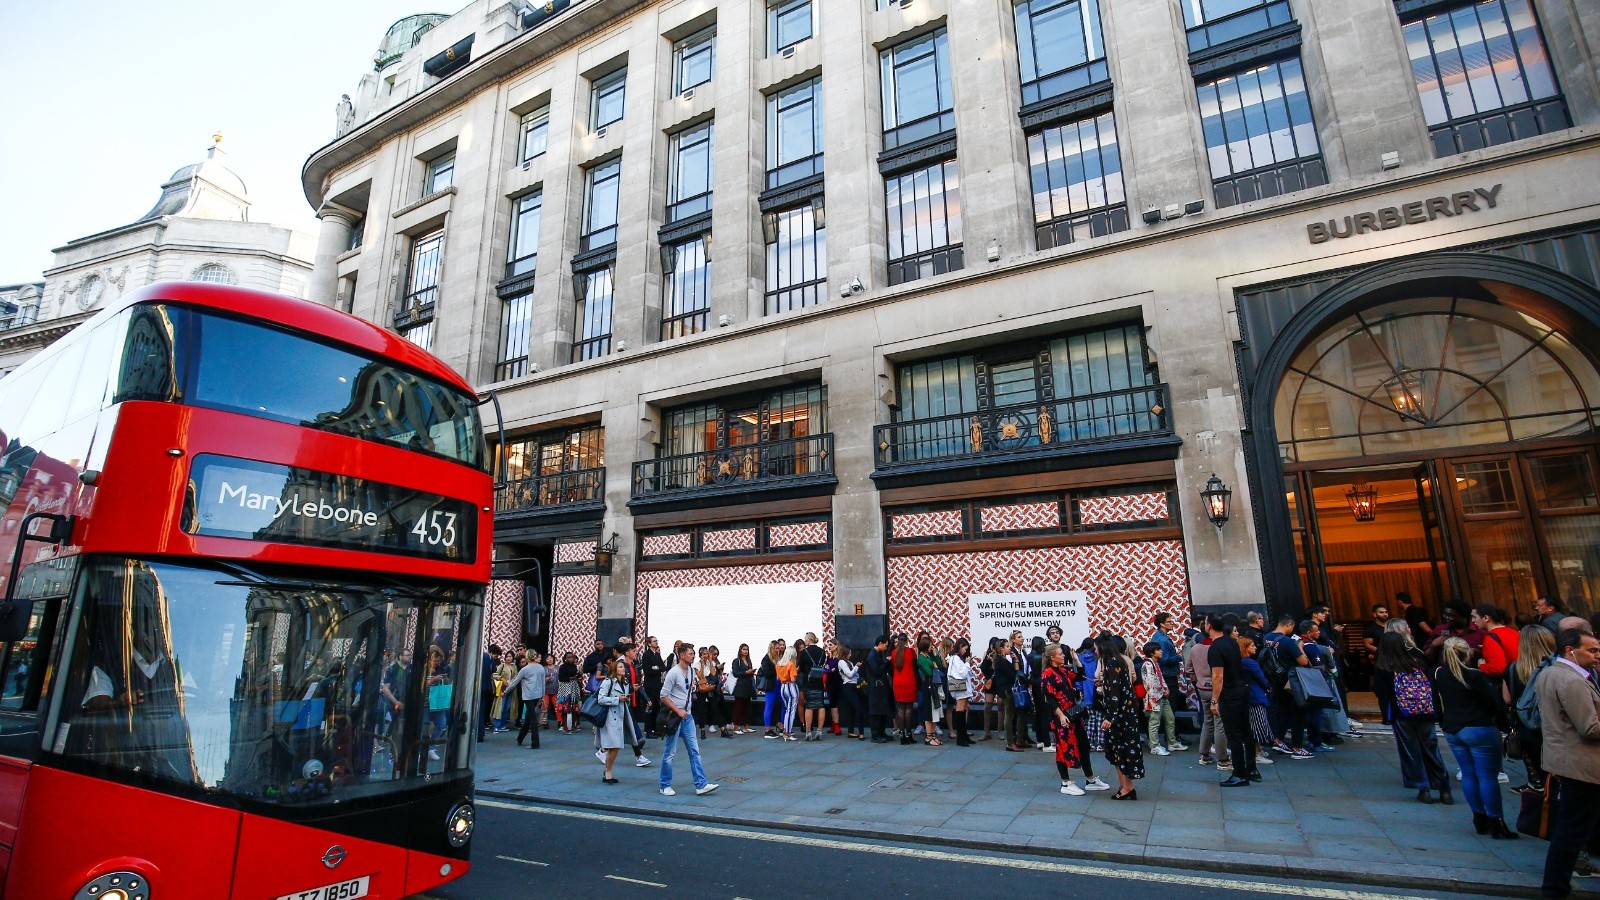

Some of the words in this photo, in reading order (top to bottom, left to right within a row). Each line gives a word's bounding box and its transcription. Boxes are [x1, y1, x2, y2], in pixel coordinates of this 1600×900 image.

[1307, 183, 1503, 244] BURBERRY
[218, 481, 378, 526] Marylebone
[411, 509, 457, 547] 453
[855, 604, 863, 614] H
[1009, 601, 1027, 609] THE
[1028, 600, 1077, 608] BURBERRY
[979, 610, 1054, 618] SPRING/SUMMER
[1055, 609, 1076, 617] 2019
[994, 620, 1032, 628] RUNWAY
[1034, 619, 1061, 627] SHOW
[287, 889, 320, 900] TZ
[323, 880, 359, 900] 1850
